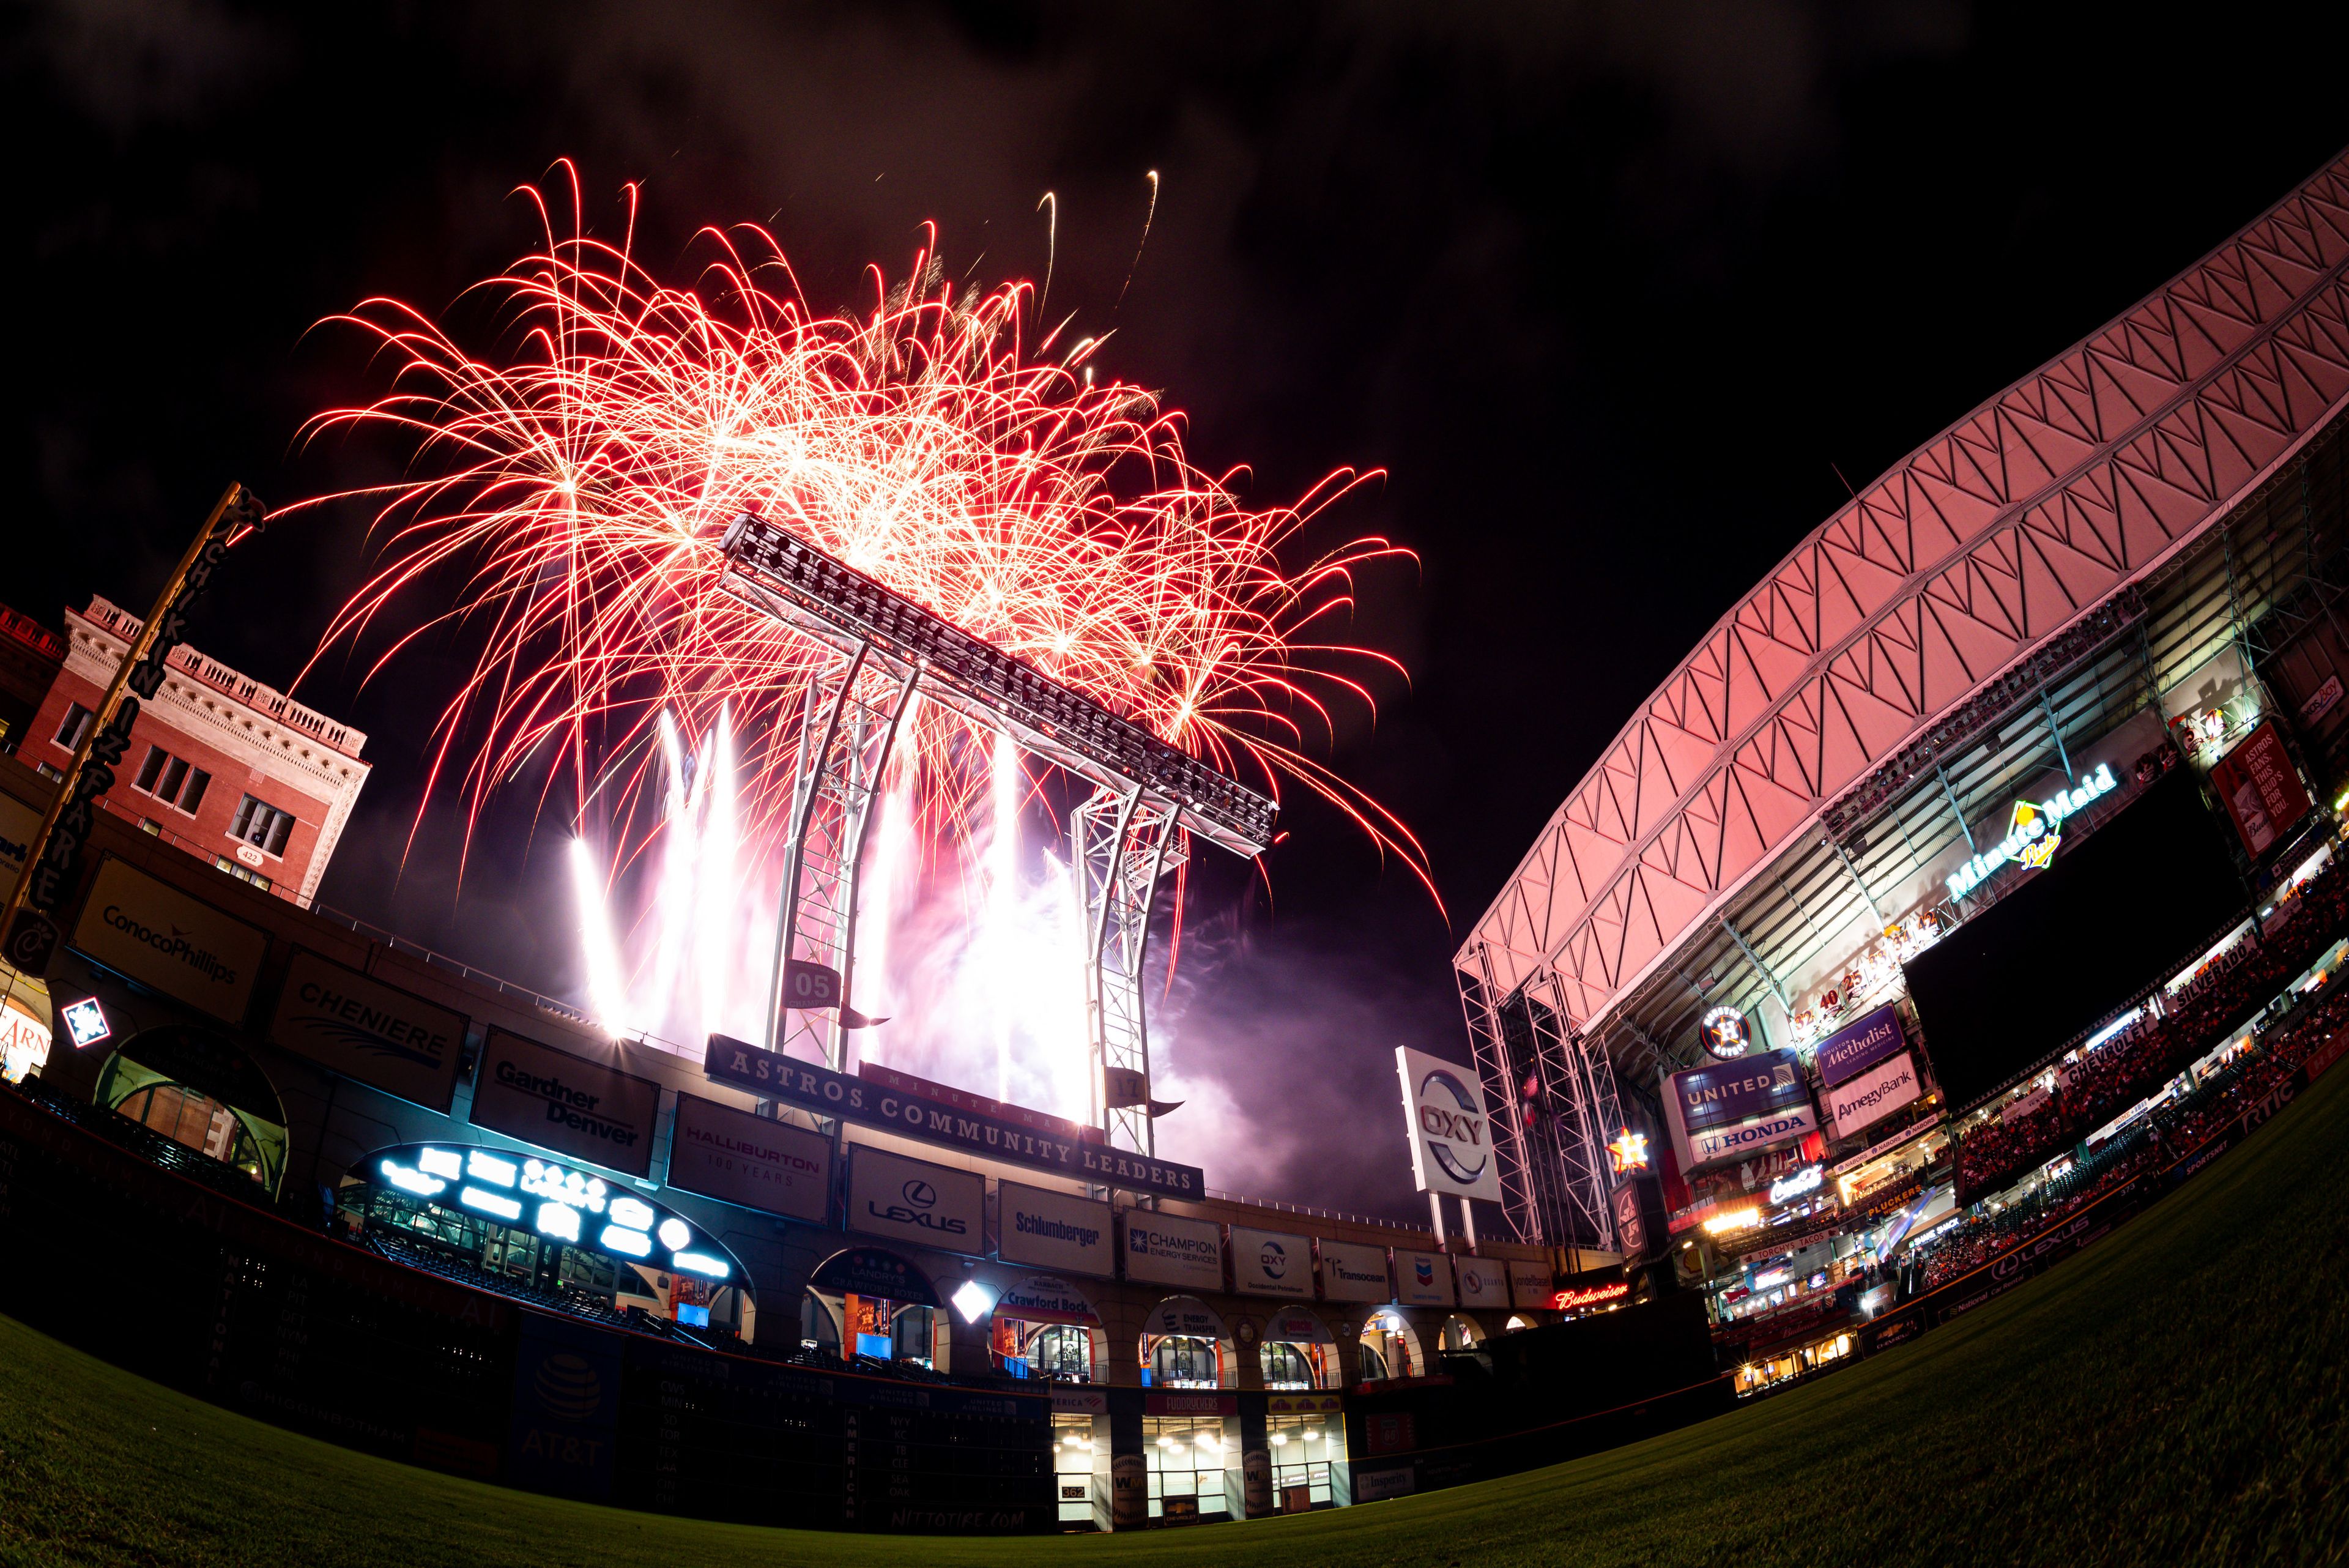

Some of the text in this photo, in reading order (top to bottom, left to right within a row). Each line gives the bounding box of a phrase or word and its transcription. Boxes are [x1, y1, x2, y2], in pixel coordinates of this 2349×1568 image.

[2245, 734, 2273, 765] ASTROS
[2249, 751, 2273, 775] FANS,
[2254, 765, 2274, 784] THIS
[2260, 771, 2284, 796] BUD'S
[2266, 788, 2282, 807] FOR
[2270, 798, 2290, 818] YOU.
[1945, 763, 2117, 903] Minute Maid
[242, 851, 258, 863] 422
[102, 904, 238, 985] ConocoPhillips
[795, 972, 829, 998] 05
[1843, 969, 1863, 992] 25
[2176, 944, 2247, 1008] SILVERADO
[1820, 989, 1839, 1010] 40
[299, 982, 448, 1057] CHENIERE
[1822, 1039, 1850, 1057] HOUSTON
[1826, 1022, 1893, 1069] Methodist
[1869, 1035, 1895, 1052] MEDICINE
[2068, 1020, 2150, 1085] CHEVROLET
[495, 1060, 599, 1110] Gardner
[1115, 1077, 1138, 1098] 17
[1687, 1076, 1771, 1106] UNITED
[1838, 1070, 1912, 1121] AmegyBank
[730, 1050, 1191, 1190] ASTROS COMMUNITY LEADERS
[2241, 1080, 2295, 1137] RTIC
[546, 1104, 638, 1148] Denver
[1420, 1104, 1483, 1145] OXY
[1723, 1115, 1807, 1148] HONDA
[1912, 1117, 1935, 1132] NABORS
[686, 1125, 820, 1175] HALLIBURTON
[1616, 1133, 1649, 1165] H
[1879, 1135, 1901, 1151] NABORS
[1845, 1153, 1868, 1169] NABORS
[2186, 1139, 2228, 1176] SPORTSNET
[707, 1154, 794, 1187] 100 YEARS
[1868, 1183, 1923, 1217] PLUCKERS
[868, 1199, 967, 1236] LEXUS
[1015, 1211, 1100, 1247] Schlumberger
[1936, 1217, 1961, 1235] SHACK
[1149, 1232, 1217, 1255] CHAMPION
[1757, 1232, 1825, 1259] TORCHYS TACOS
[2021, 1215, 2090, 1262] LEXUS
[1150, 1247, 1218, 1265] ENERGY SERVICES
[1260, 1254, 1286, 1266] OXY
[851, 1266, 906, 1284] LANDRY'S
[1337, 1268, 1386, 1284] Transocean
[831, 1276, 924, 1301] CRAWFORD BOXES
[1555, 1284, 1630, 1310] Budweiser
[1958, 1274, 2025, 1313] National Car Rental
[1008, 1291, 1088, 1313] Crawford Bock
[1183, 1314, 1209, 1324] ENERGY
[1184, 1323, 1217, 1334] TRANSFER
[1166, 1395, 1219, 1411] FUDDRUCKERS
[519, 1427, 605, 1468] AT&T
[1063, 1487, 1085, 1498] 362
[1115, 1476, 1145, 1489] WM
[1370, 1472, 1406, 1488] Insperity
